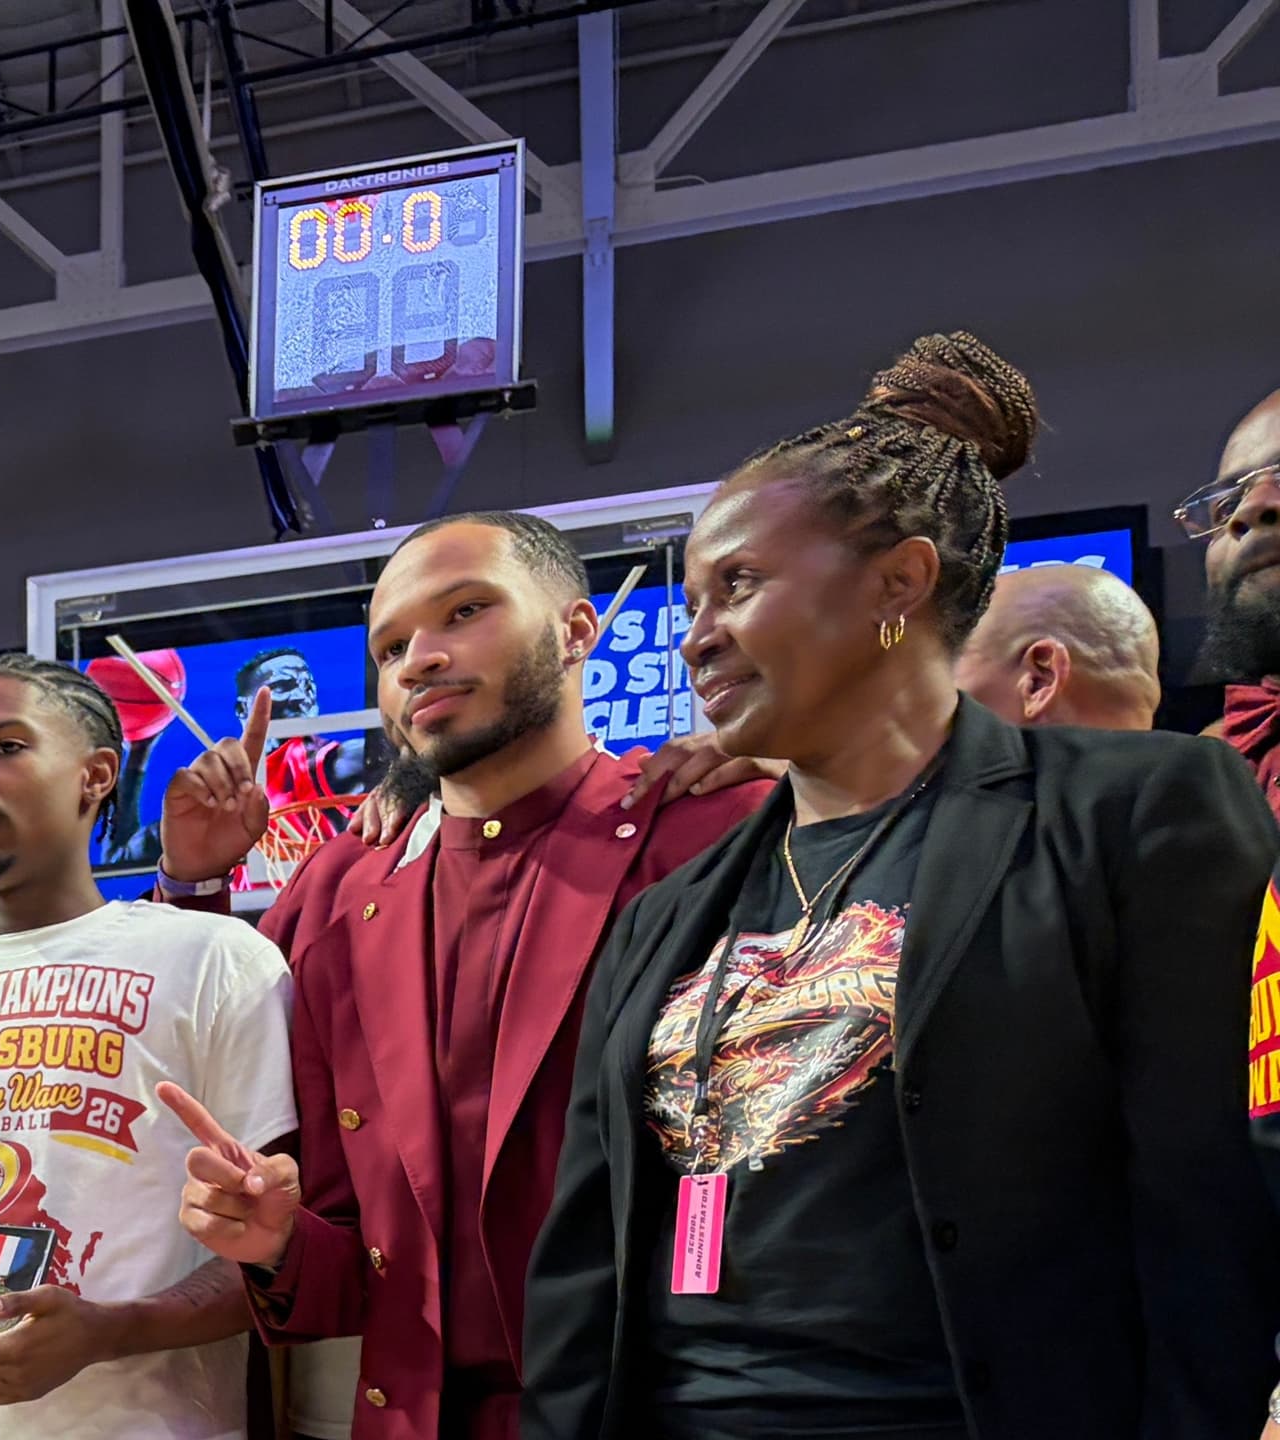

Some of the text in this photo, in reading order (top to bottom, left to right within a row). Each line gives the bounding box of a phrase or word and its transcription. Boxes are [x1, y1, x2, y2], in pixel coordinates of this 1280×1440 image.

[325, 162, 449, 192] DAKTRONICS
[288, 190, 442, 271] 00.0
[7, 1070, 83, 1113] Wave
[85, 1097, 125, 1134] 26
[687, 1213, 698, 1255] SCHOOL
[694, 1188, 709, 1279] ADMINISTRATOR
